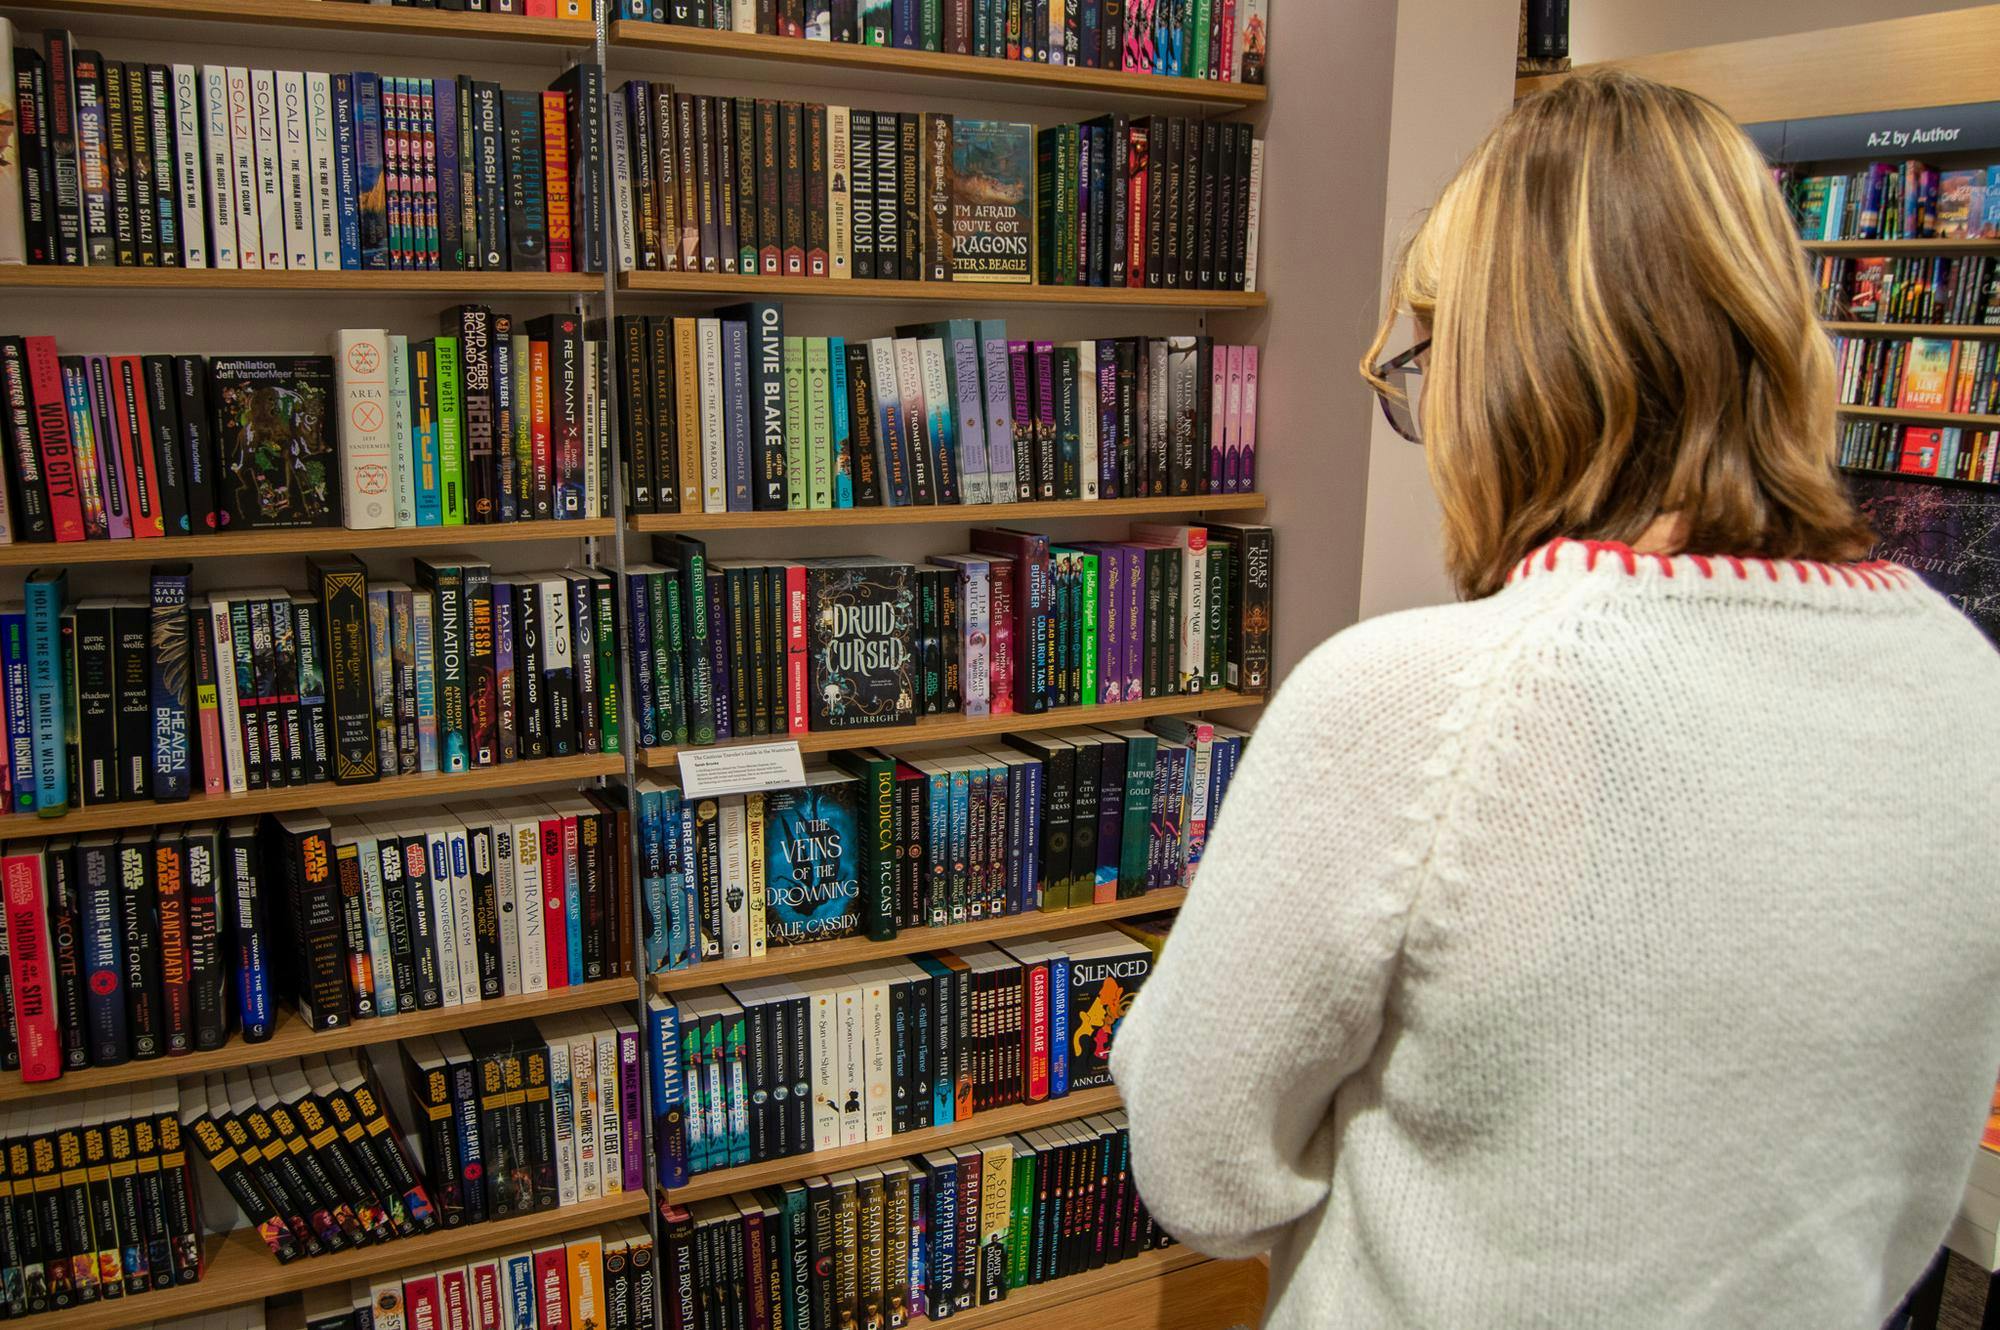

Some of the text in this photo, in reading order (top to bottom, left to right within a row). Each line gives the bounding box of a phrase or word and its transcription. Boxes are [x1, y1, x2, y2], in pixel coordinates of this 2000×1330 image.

[18, 72, 36, 135] THE FEEDING
[178, 74, 192, 136] SCALZI
[588, 73, 596, 113] INNER
[107, 68, 130, 242] STARTER VILLAIN JOHN SCALZI
[482, 90, 496, 184] SNOW CRASH
[543, 97, 569, 162] EARTH
[1867, 127, 1960, 147] A-Z by Author
[79, 84, 106, 233] THE SHATTERING PEACE
[338, 99, 353, 216] Meet Me in Another Life
[852, 140, 872, 253] NINTH HOUSE
[955, 205, 1016, 218] I'M AFRAID
[953, 221, 1018, 232] YOU'VE GOT
[989, 259, 1026, 270] BEAGLE
[216, 361, 275, 370] Annihilation
[217, 370, 291, 379] Jeff VanderMeer
[463, 313, 478, 388] RICHARD FOX
[476, 313, 488, 390] DAVID WEBER
[762, 309, 781, 445] OLIVIE BLAKE
[876, 348, 887, 398] BOUCHET
[883, 350, 893, 395] AMANDA
[154, 362, 166, 410] Acceptance
[184, 360, 192, 397] Authority
[350, 390, 381, 398] AREA
[564, 340, 575, 423] REVENANT
[417, 352, 434, 490] HENCH
[439, 347, 456, 472] peter watts blindsight
[467, 397, 493, 461] REBEL
[534, 353, 546, 491] THE MARTIAN ANDY WEIR
[39, 402, 75, 498] WOMB CITY
[1017, 441, 1025, 482] BRENNAN
[1249, 547, 1258, 584] KNOT
[1258, 549, 1267, 588] LIAR'S
[692, 561, 706, 637] TERRY BROOKS
[832, 602, 896, 640] DRUID
[83, 642, 105, 651] wolfe
[85, 635, 103, 643] gene
[441, 591, 460, 680] RUINATION
[473, 599, 490, 656] AMBESSA
[522, 589, 537, 703] HALO THE FLOOD
[1030, 564, 1046, 692] BUTCHER COLD IRON TASK
[826, 638, 902, 675] CURSED
[34, 591, 55, 790] HOLE IN THE SKY DANIEL WILSON
[82, 692, 110, 700] shadow
[123, 704, 148, 712] citadel
[124, 690, 146, 698] sword
[200, 694, 215, 704] WE
[14, 663, 32, 779] THE ROAD TO ROSWELL
[156, 707, 170, 774] BREAKER
[172, 710, 184, 770] HEAVEN
[830, 713, 900, 726] C.J. BURRIGHT
[780, 836, 843, 864] VEINS
[796, 818, 829, 832] IN THE
[878, 772, 892, 918] BOUDICCA CAST
[682, 822, 694, 890] BREAKFAST
[793, 866, 835, 880] OF THE
[310, 915, 335, 924] TRILOGY
[312, 902, 328, 910] DARK
[313, 909, 330, 917] LORD
[416, 890, 428, 936] NEW DAWN
[458, 888, 472, 945] CATACLYSM
[523, 866, 538, 936] THRAWN
[767, 880, 859, 906] DROWNING
[57, 916, 76, 975] ACOLYTE
[125, 895, 142, 988] LIVING FORCE
[161, 900, 185, 985] SANCTUARY
[438, 888, 451, 954] CONVERGENCE
[767, 914, 861, 937] KALIE CASSIDY
[14, 912, 42, 1017] SHADOW OF THE SITH
[1073, 960, 1147, 986] SILENCED
[1034, 974, 1044, 1052] CASSANDRA CLARE
[661, 1017, 679, 1103] MALINALLI
[1073, 1076, 1093, 1087] ANN
[554, 1089, 571, 1141] AFTERMATH
[603, 1113, 619, 1157] LIFE DEBT
[235, 1171, 266, 1212] SCOUNDRELS
[984, 1173, 996, 1230] KEEPER
[996, 1178, 1008, 1218] SOUL
[843, 1211, 855, 1298] SLAIN DIVINE
[942, 1188, 954, 1291] SAPPHIRE ALTAR
[964, 1181, 978, 1277] BLADED FAITH
[678, 1246, 694, 1322] FIVE BROKEN
[987, 1246, 995, 1287] DALGLISH
[993, 1250, 1001, 1276] DAVID
[544, 1276, 562, 1326] BLADE ITSELF
